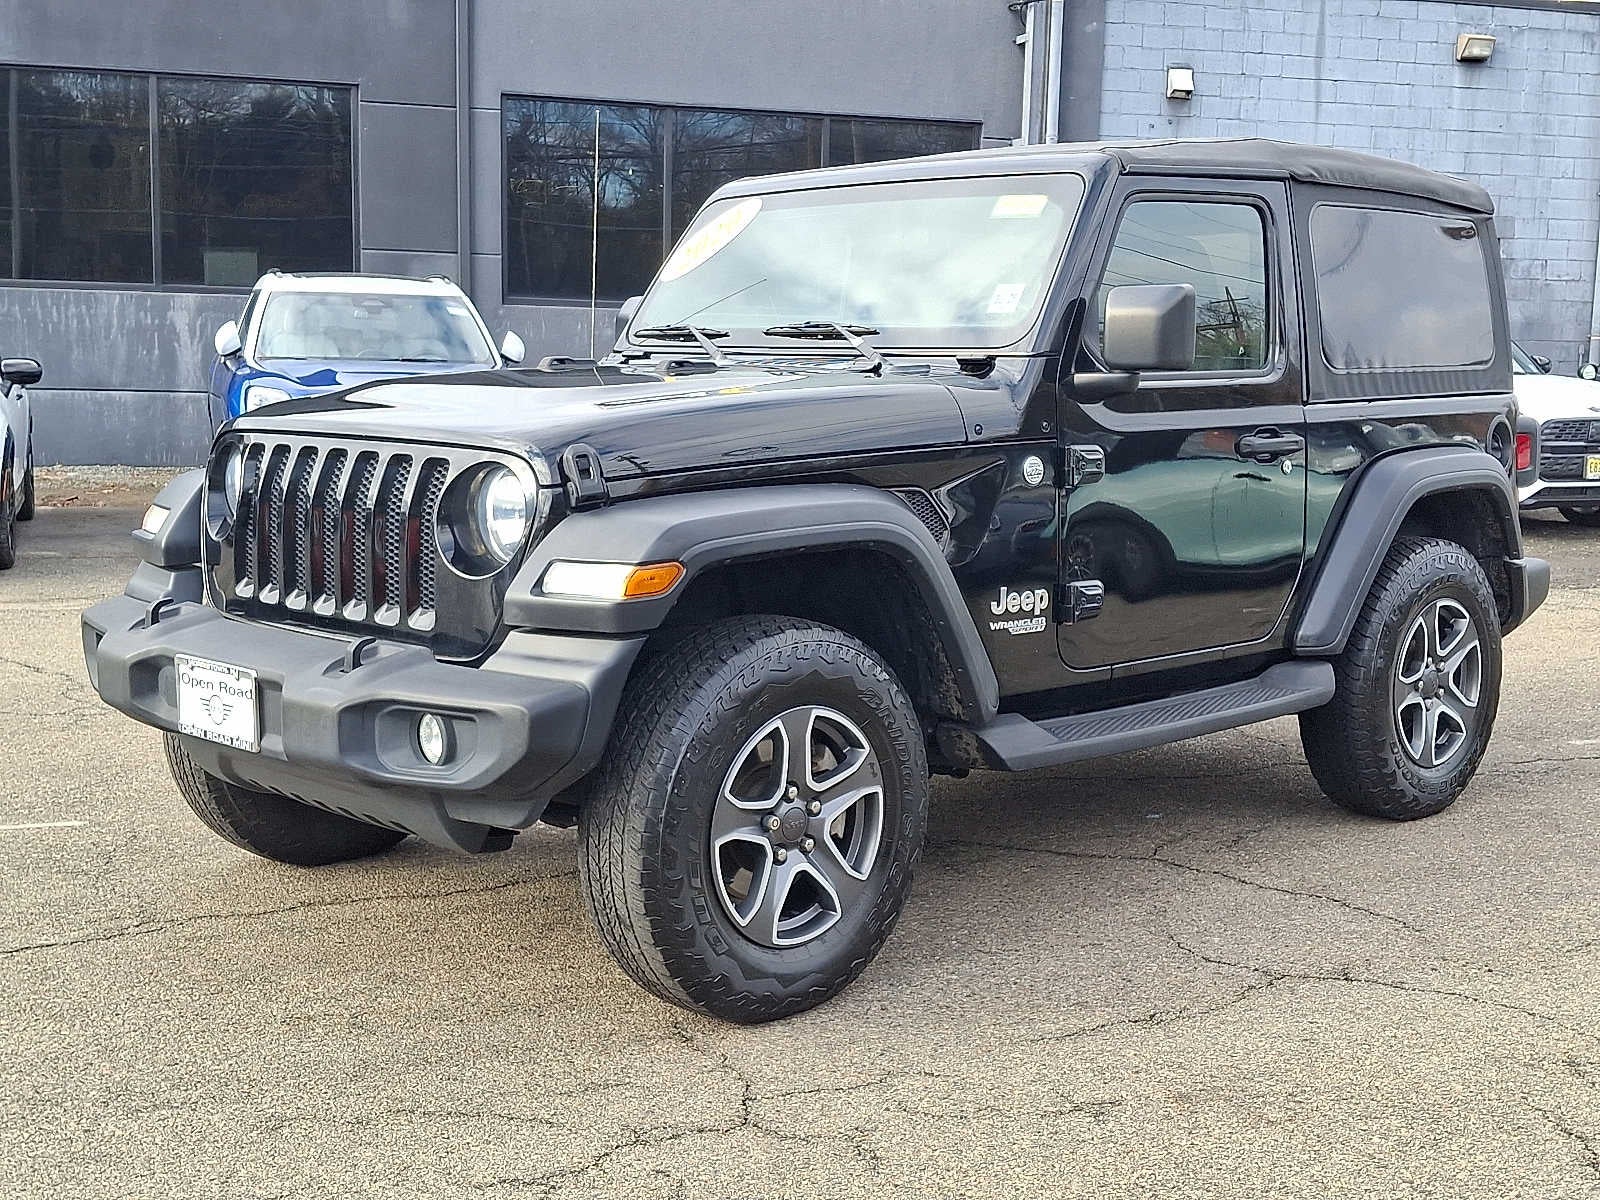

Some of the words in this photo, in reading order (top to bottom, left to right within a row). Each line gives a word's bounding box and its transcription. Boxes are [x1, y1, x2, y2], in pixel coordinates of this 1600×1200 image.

[990, 586, 1049, 616] Jeep
[989, 616, 1046, 630] WRANGLER
[181, 672, 214, 691] Open
[219, 681, 254, 701] Road
